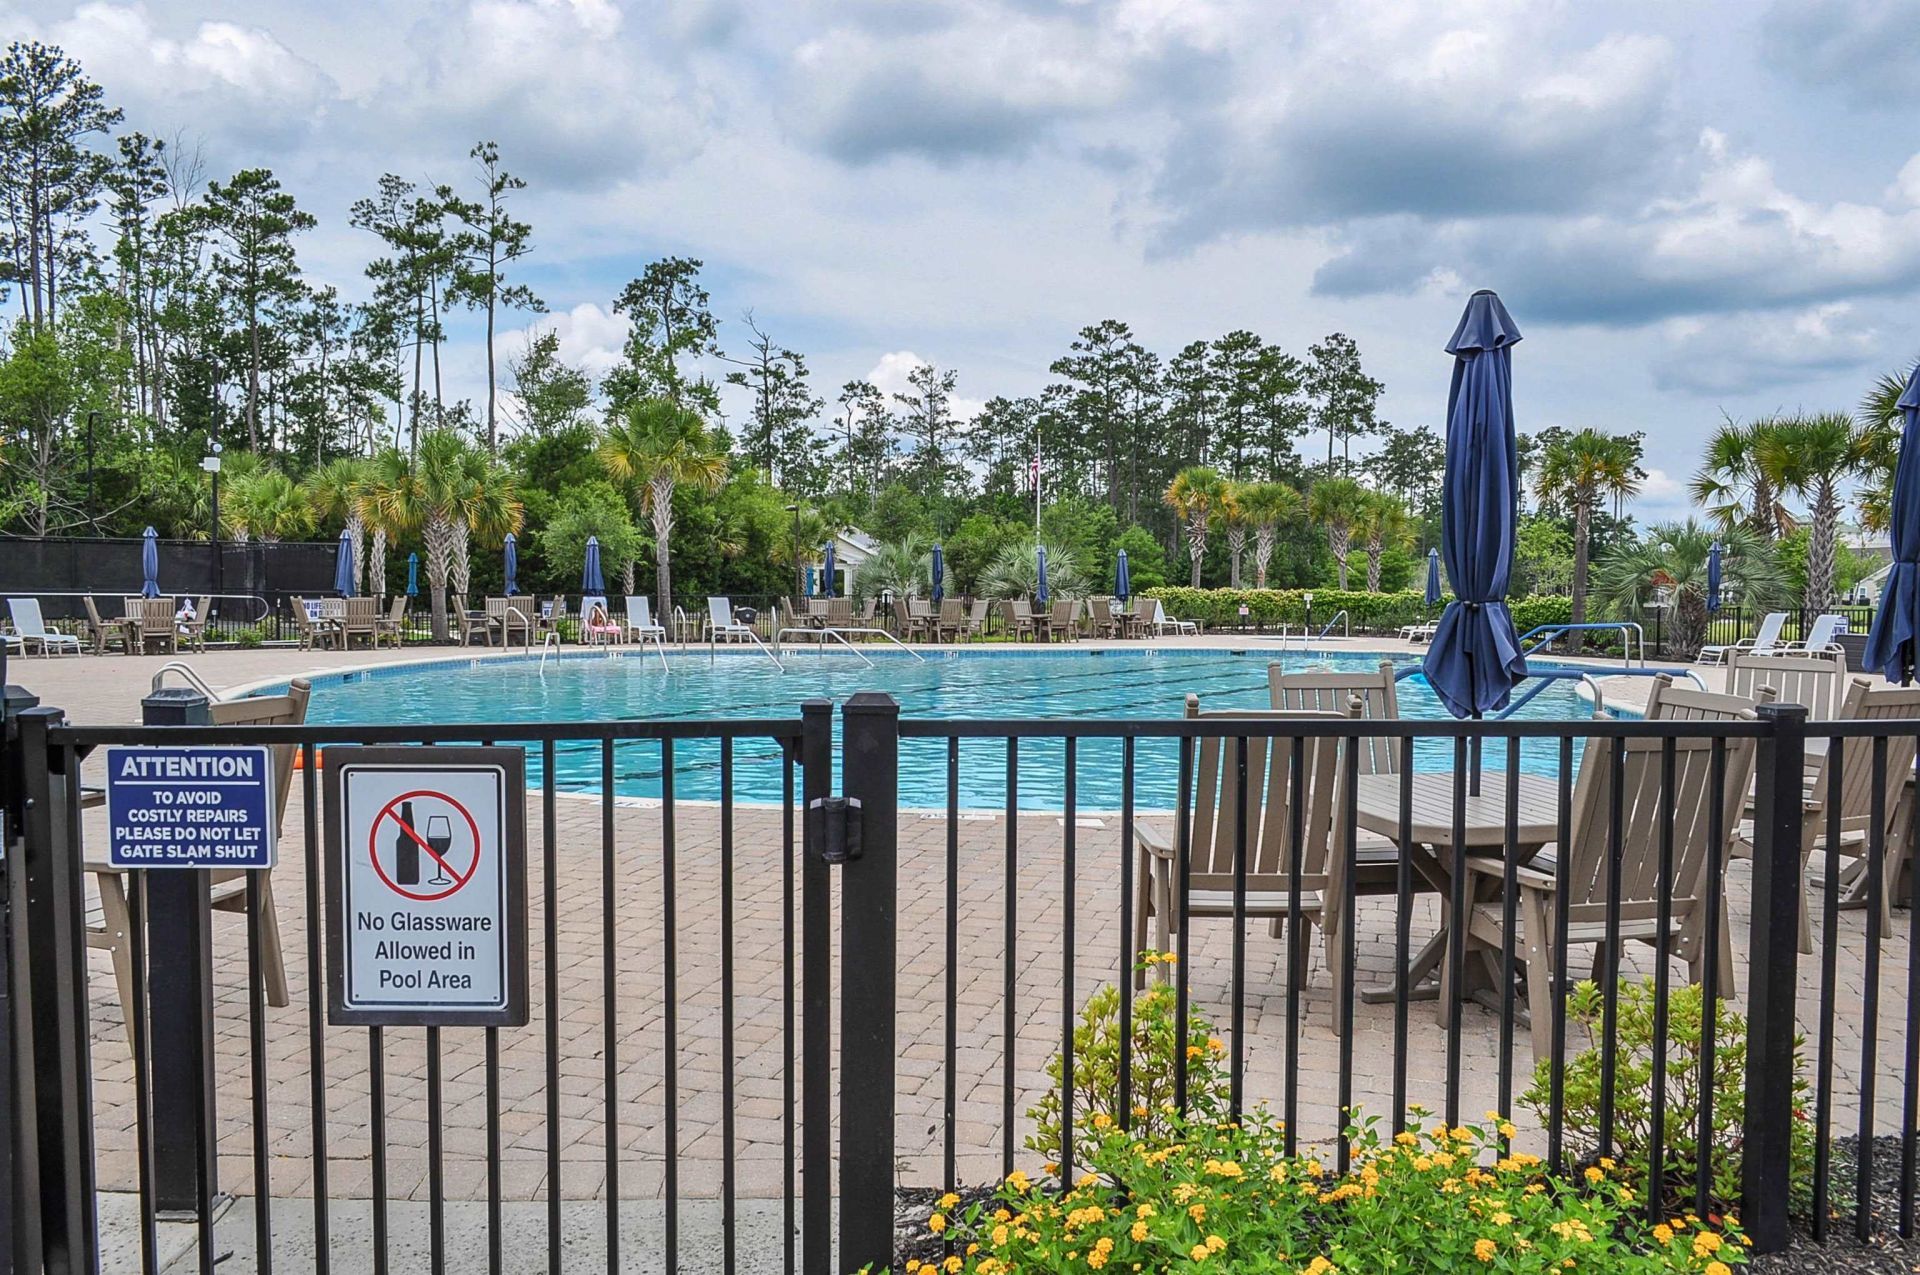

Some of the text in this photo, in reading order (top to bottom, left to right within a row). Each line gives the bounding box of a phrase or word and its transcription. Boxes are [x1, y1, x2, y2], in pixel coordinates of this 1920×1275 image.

[120, 756, 252, 776] ATTENTION
[153, 792, 222, 804] TO AVOID
[128, 809, 248, 822] COSTLY REPAIRS
[116, 828, 261, 840] PLEASE DO NOT LET
[120, 845, 258, 858] GATE SLAM SHUT
[358, 912, 492, 932] No Glassware
[374, 940, 475, 960] Allowed in
[380, 970, 472, 989] Pool Area
